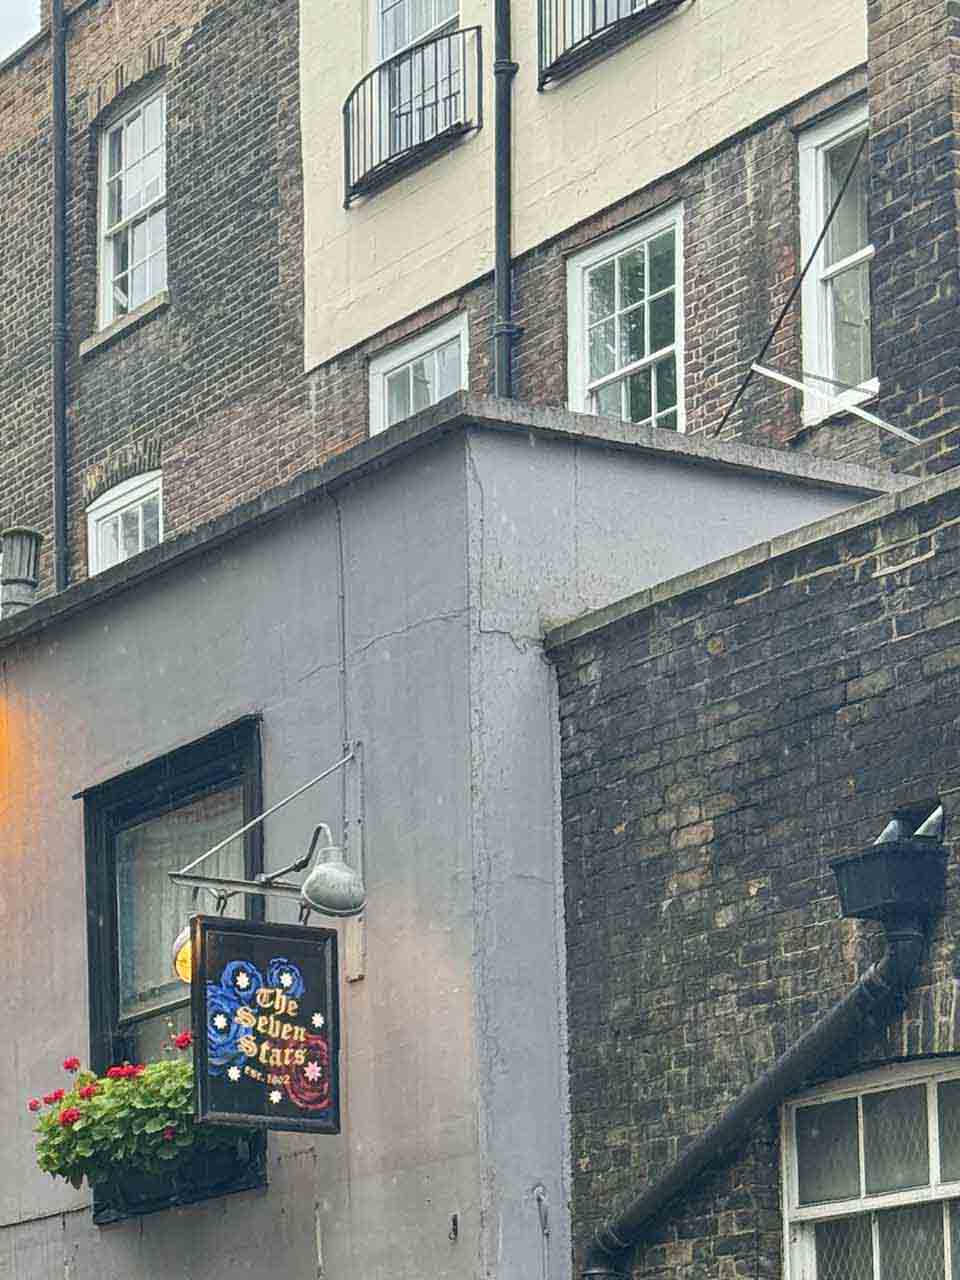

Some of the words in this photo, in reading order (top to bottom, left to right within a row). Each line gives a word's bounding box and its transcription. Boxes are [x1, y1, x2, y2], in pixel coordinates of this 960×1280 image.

[256, 987, 298, 1016] The
[235, 1006, 307, 1041] Seven
[236, 1035, 309, 1067] Stars
